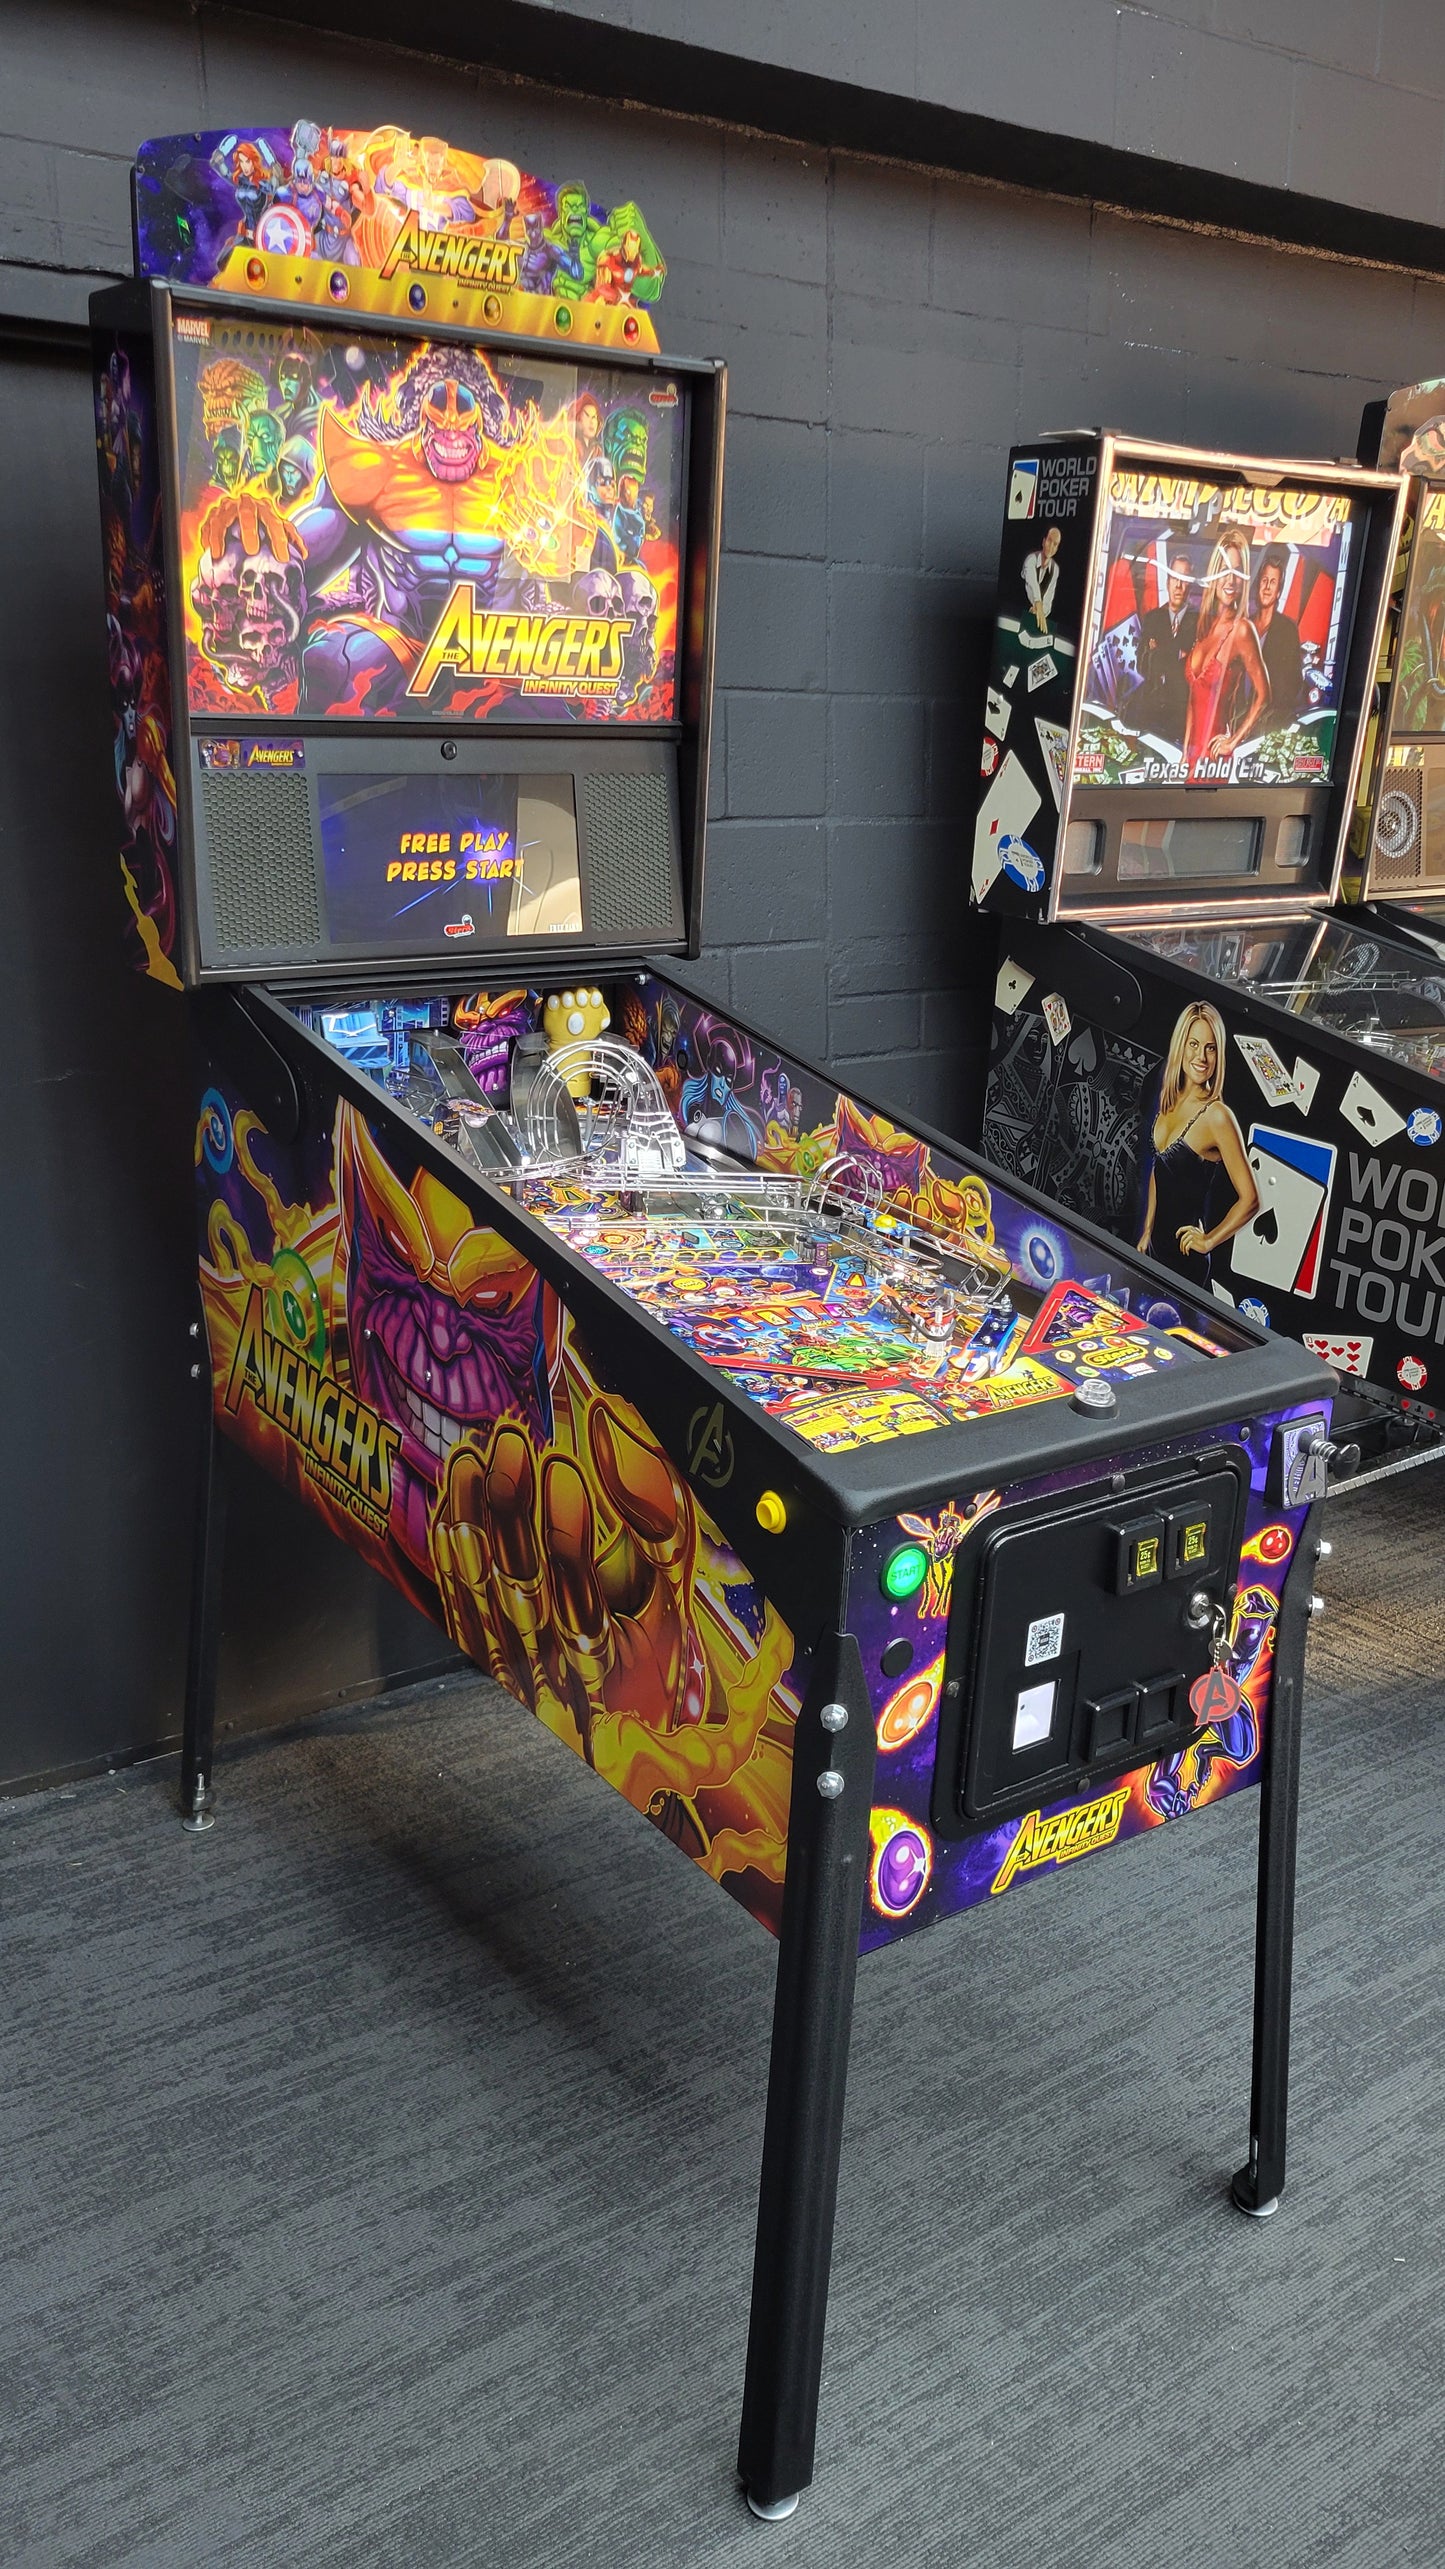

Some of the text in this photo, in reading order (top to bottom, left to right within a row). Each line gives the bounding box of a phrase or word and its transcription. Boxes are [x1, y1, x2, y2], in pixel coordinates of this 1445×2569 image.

[380, 209, 524, 280] AVENGERS
[178, 318, 210, 337] MARVEL
[1042, 456, 1097, 478] WORLD
[1040, 478, 1089, 498] POKER
[1038, 499, 1077, 518] TOUR
[410, 583, 634, 695] THE AVENGERS
[525, 680, 619, 696] INFINITY QUEST
[248, 744, 295, 767] AVENGERS
[1075, 756, 1103, 767] TERN
[1143, 757, 1190, 779] Texas
[1193, 757, 1233, 779] Hold
[401, 831, 509, 854] FREE PLAY
[386, 858, 524, 882] PRESS START
[1093, 1346, 1139, 1365] Stern
[225, 1284, 402, 1515] THE AVENGERS
[985, 1376, 1058, 1407] AVENGERS
[305, 1454, 388, 1539] INFINITY QUEST
[891, 1564, 922, 1580] START
[995, 1788, 1128, 1889] AVENGERS
[1060, 1832, 1113, 1859] INFINITY QUEST
